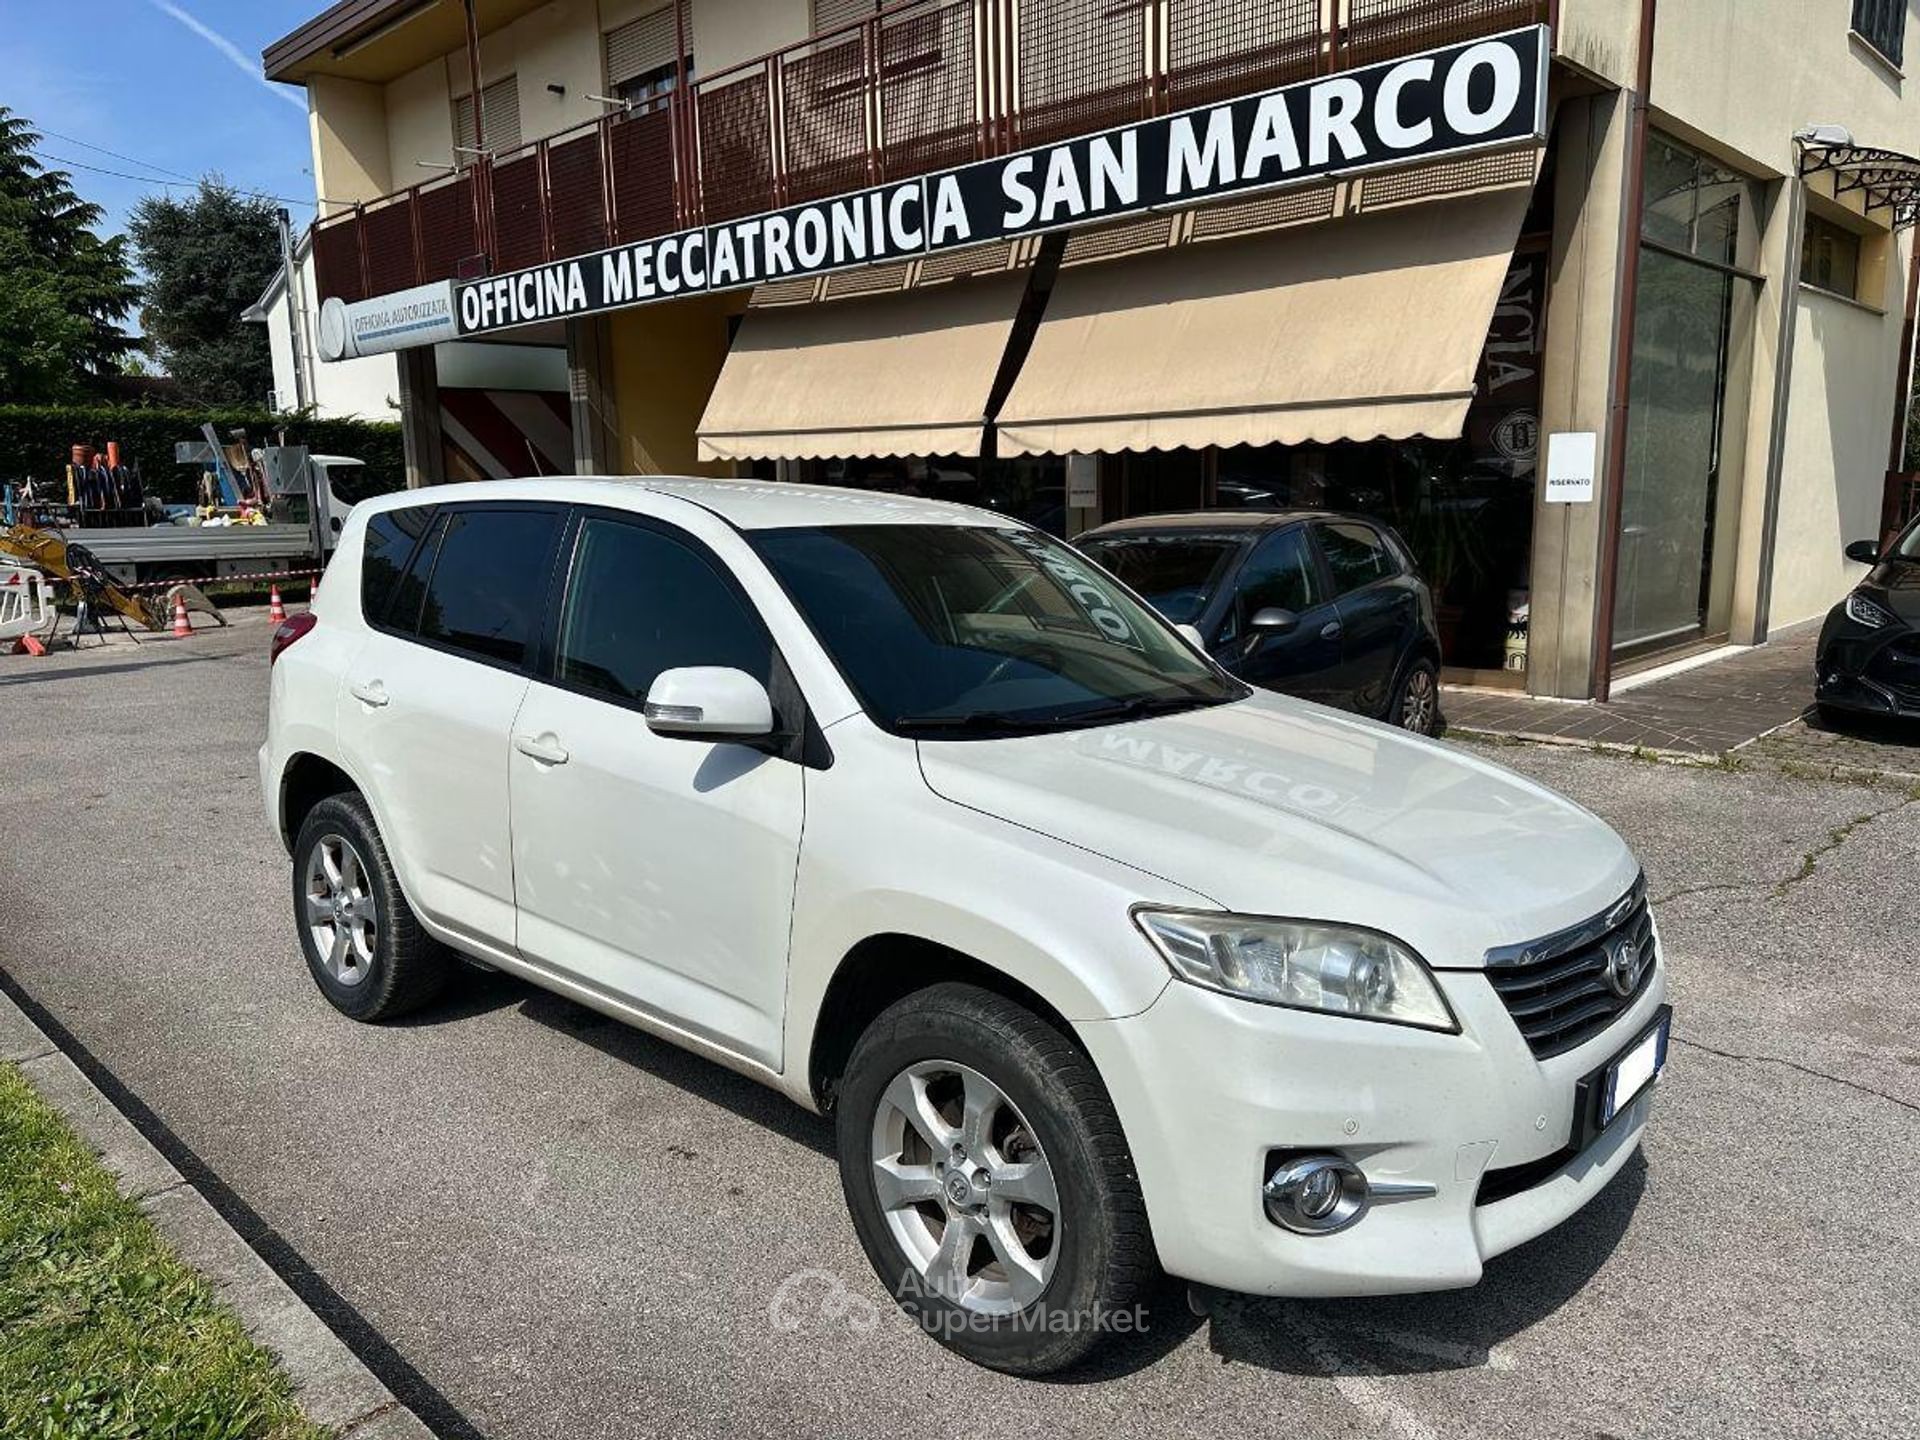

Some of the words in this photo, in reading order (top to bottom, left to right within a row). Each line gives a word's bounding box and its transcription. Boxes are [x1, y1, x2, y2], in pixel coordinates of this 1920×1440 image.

[463, 264, 588, 331] OFFICINA
[602, 175, 970, 303] MECCATRONICA
[1001, 131, 1140, 229] SAN
[1165, 41, 1521, 195] MARCO
[354, 314, 391, 332] OFFICINA
[392, 299, 450, 323] AUTORIZZATA
